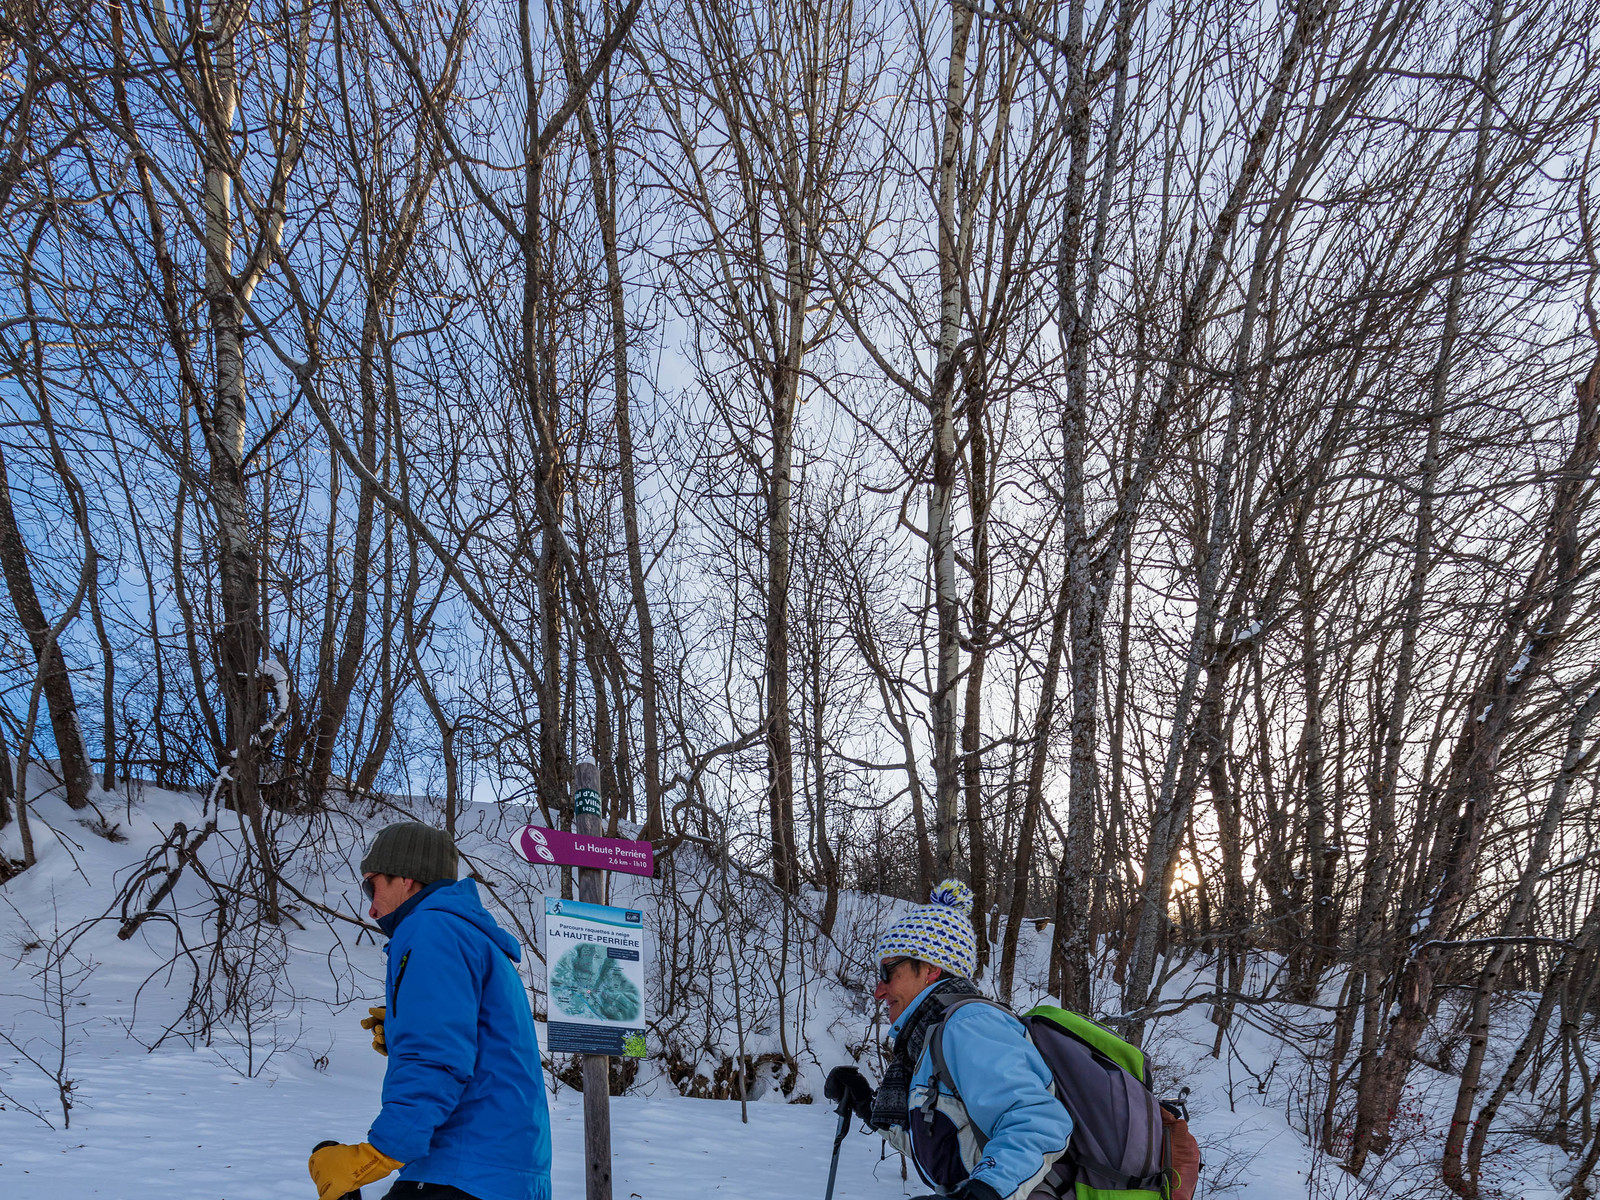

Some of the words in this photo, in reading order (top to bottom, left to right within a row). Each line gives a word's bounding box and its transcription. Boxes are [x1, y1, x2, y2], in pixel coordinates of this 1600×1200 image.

[574, 841, 585, 851] La
[588, 843, 613, 855] Haute
[615, 847, 647, 859] Perrière
[608, 857, 619, 866] 2,6
[619, 858, 628, 866] km
[633, 860, 647, 868] 1h10
[549, 929, 561, 937] LA
[559, 923, 584, 932] Parcours
[585, 927, 610, 936] raquettes
